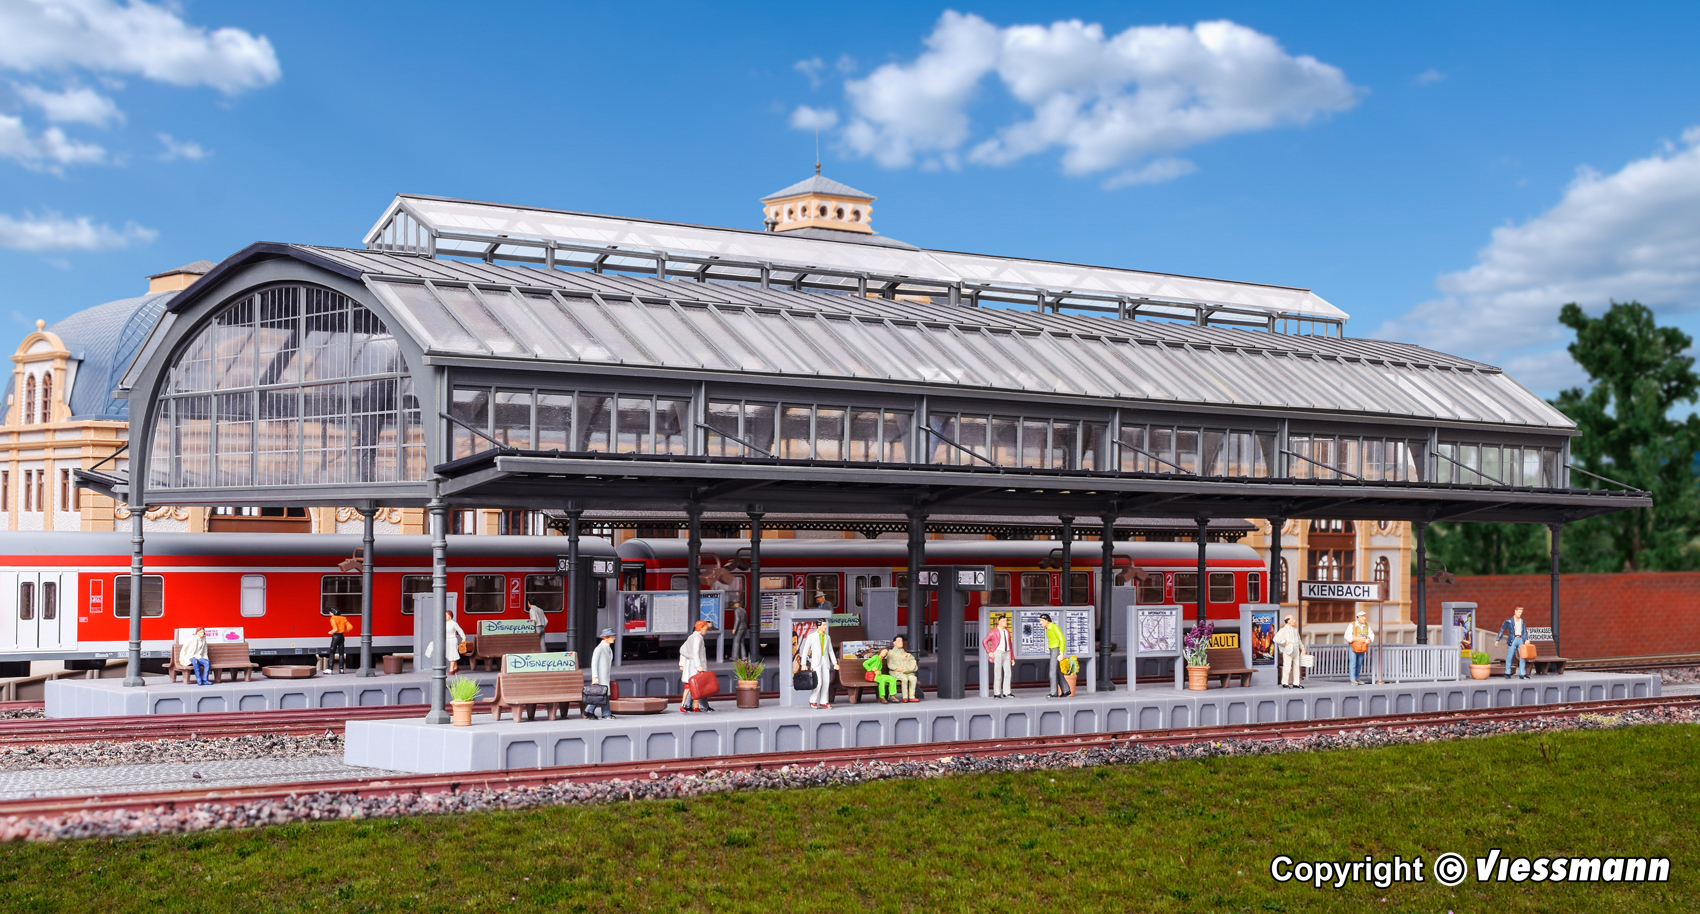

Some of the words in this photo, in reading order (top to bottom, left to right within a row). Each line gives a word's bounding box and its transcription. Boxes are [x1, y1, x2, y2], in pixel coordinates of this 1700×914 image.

[511, 579, 520, 593] 2
[797, 576, 804, 588] 2
[1166, 574, 1173, 586] 2
[1308, 584, 1370, 597] KIENBACH
